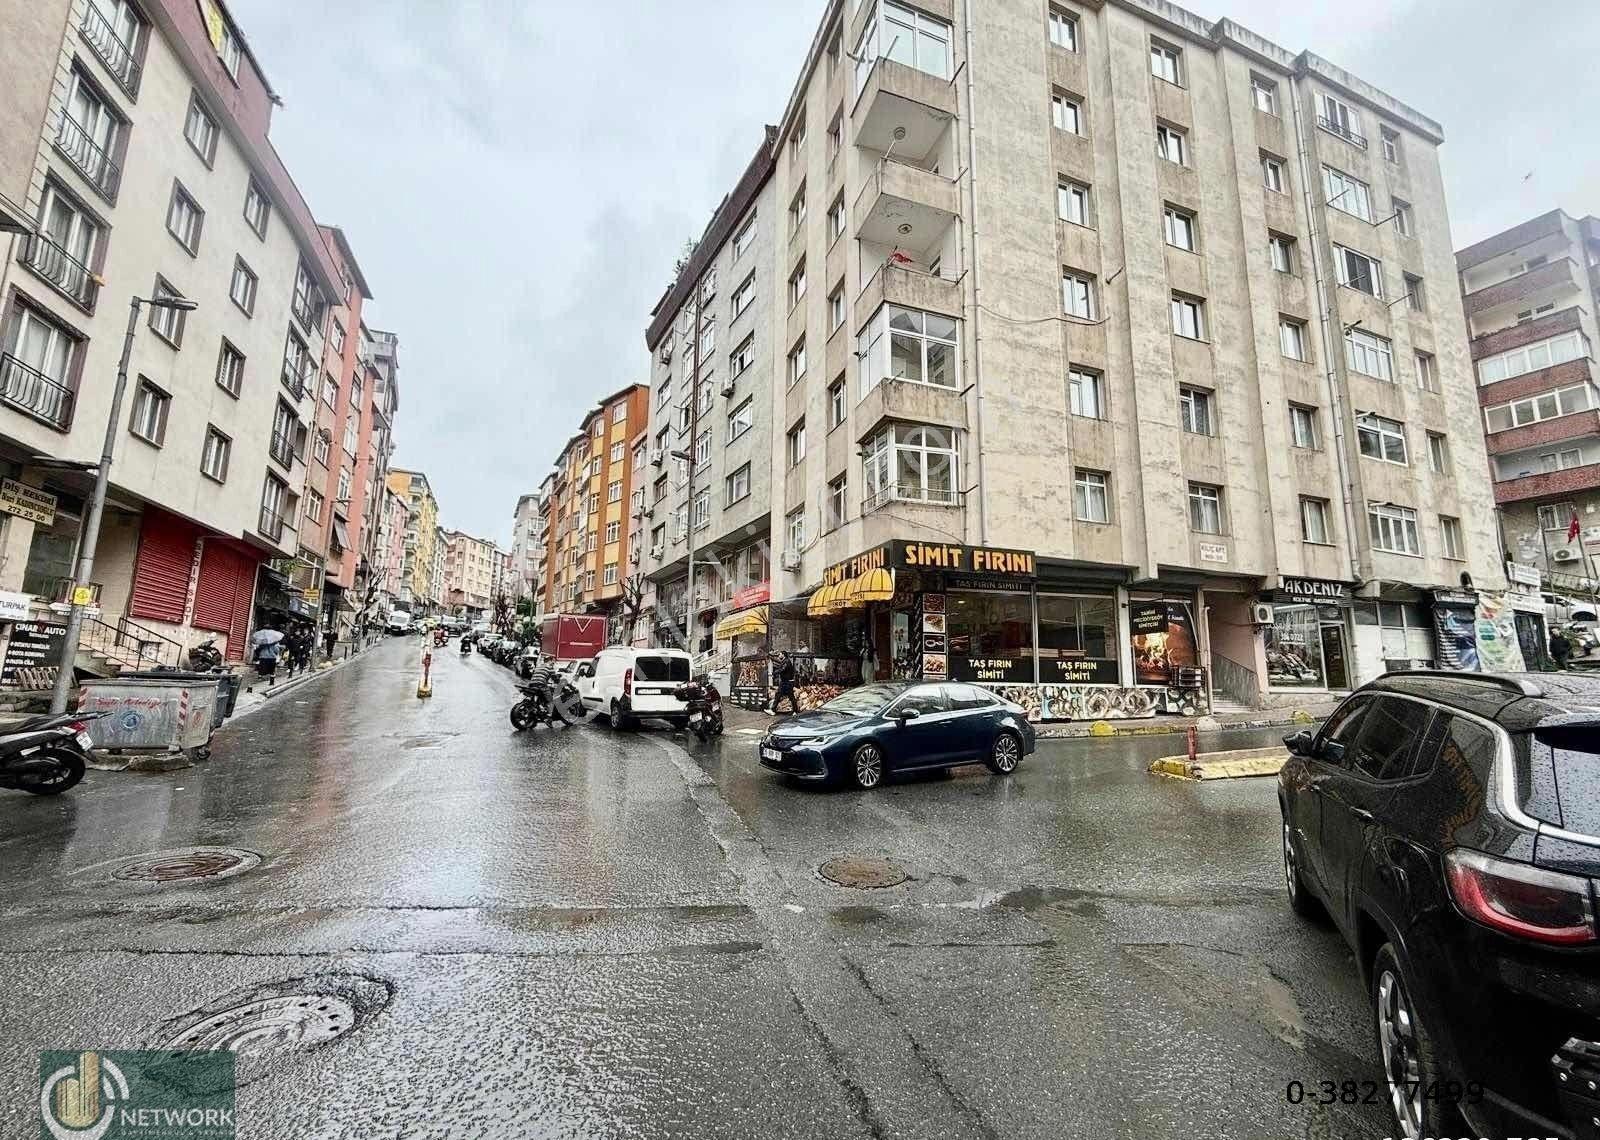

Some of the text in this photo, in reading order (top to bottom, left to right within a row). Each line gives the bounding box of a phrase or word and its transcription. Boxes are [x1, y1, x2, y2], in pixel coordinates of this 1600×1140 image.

[905, 543, 1032, 572] SİMİT FIRINI
[44, 626, 66, 636] AUTO
[968, 659, 1012, 668] TAŞ FIRIN
[1056, 661, 1097, 670] TAŞ FIRIN
[977, 670, 1004, 679] SİMİTİ
[1065, 671, 1090, 681] SİMİTİ
